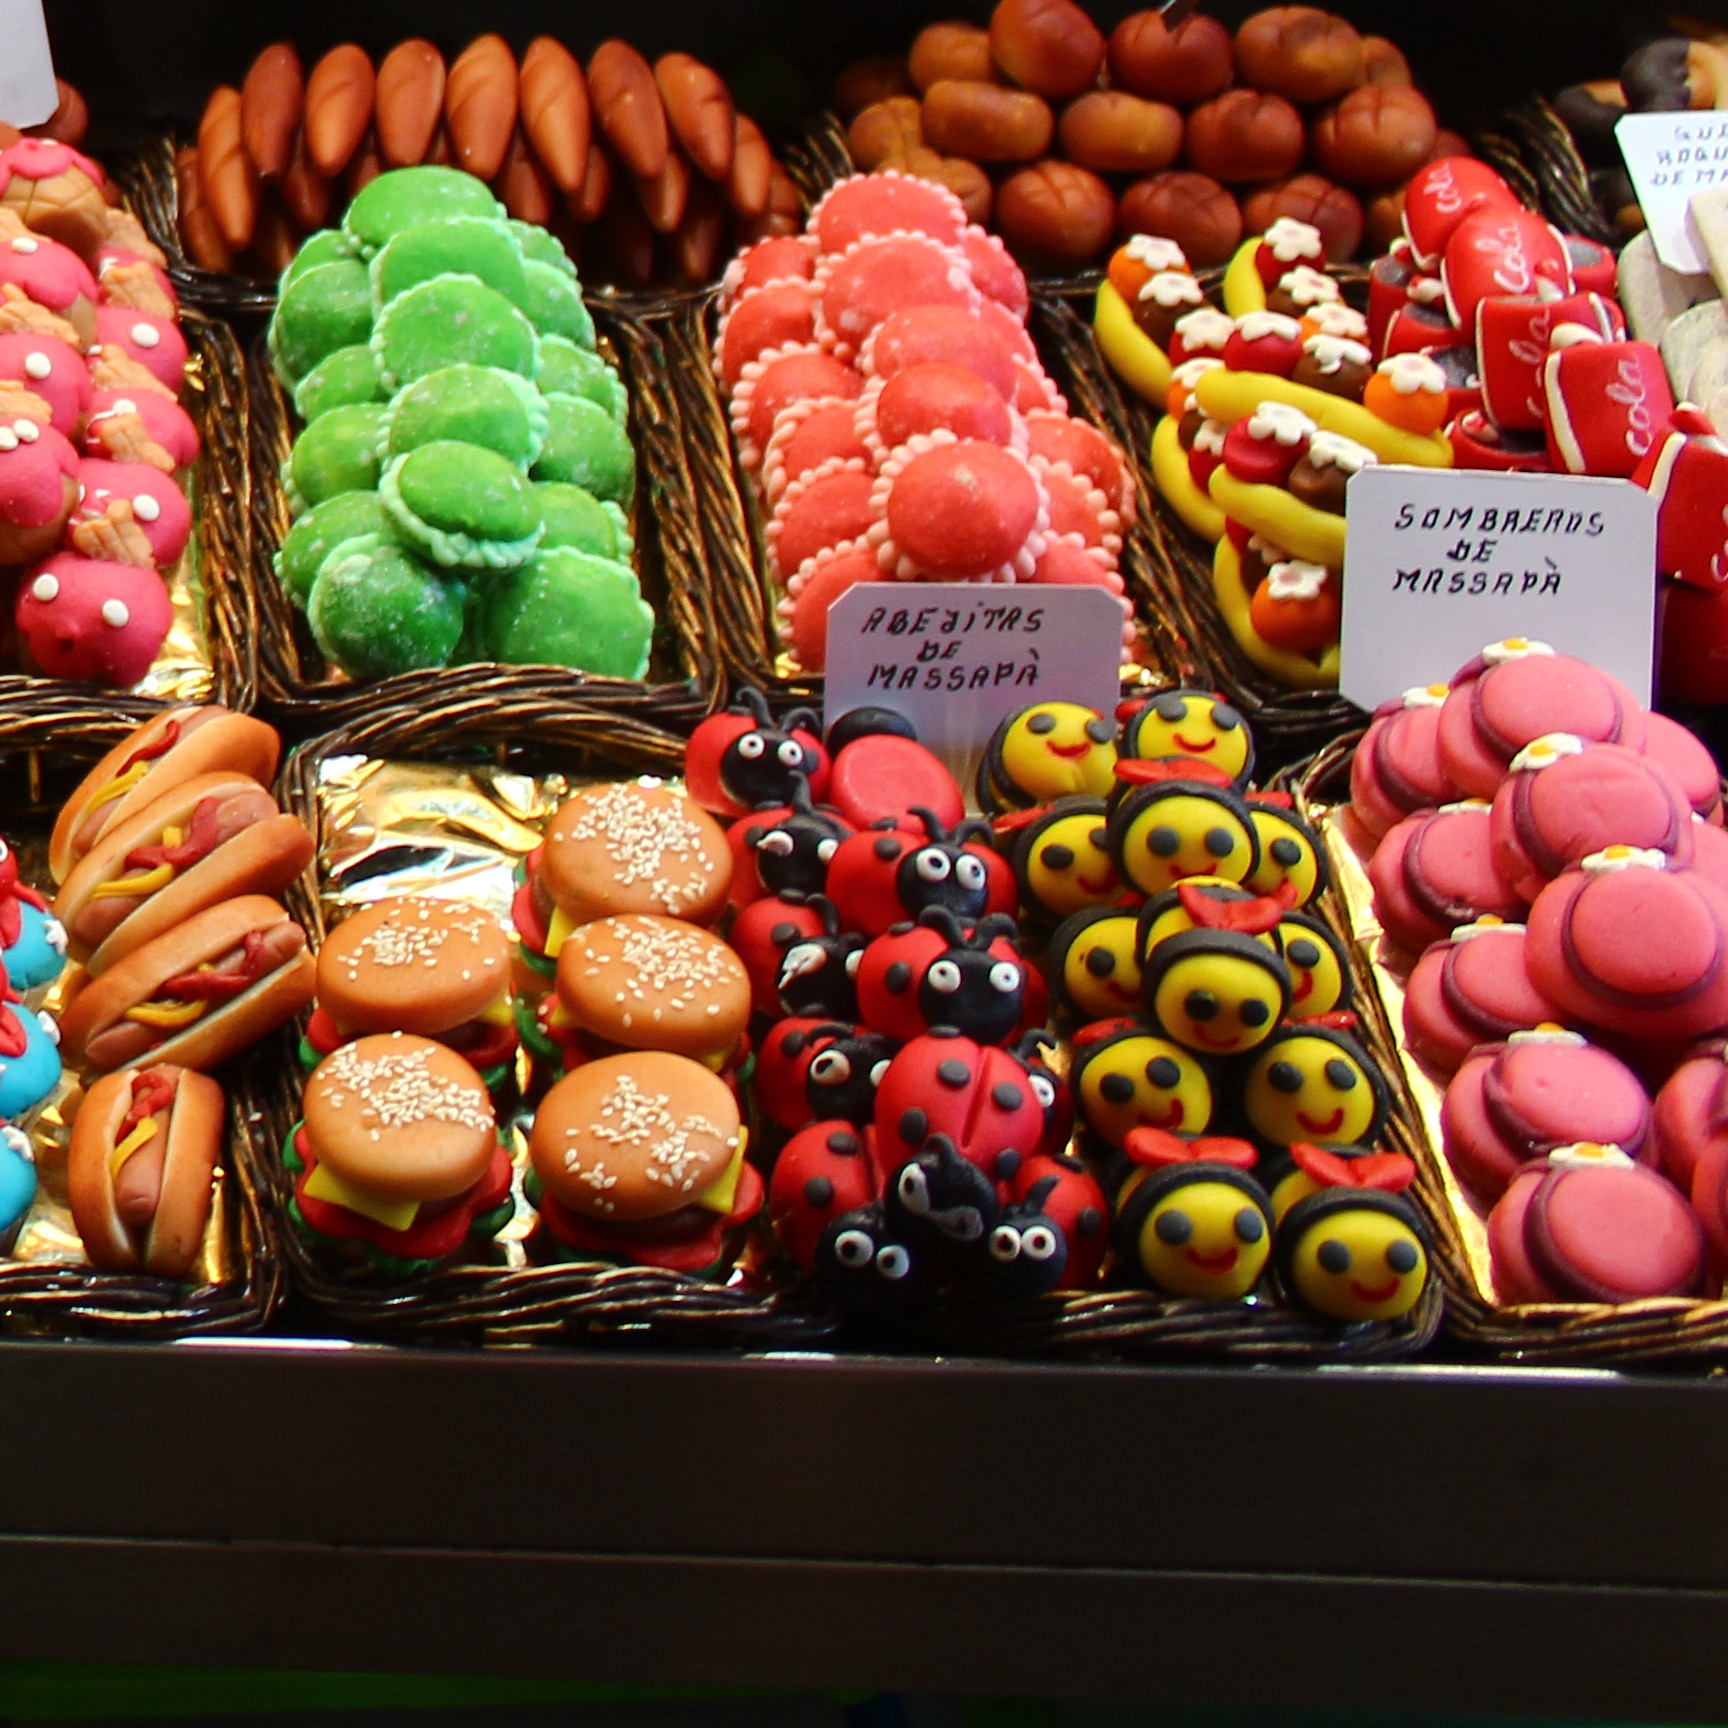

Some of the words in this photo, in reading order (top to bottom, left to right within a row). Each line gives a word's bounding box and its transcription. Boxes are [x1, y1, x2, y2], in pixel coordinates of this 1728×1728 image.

[1394, 502, 1605, 537] SOMBREROS
[1446, 538, 1498, 563] DE
[1392, 555, 1562, 596] MASSAPÀ
[861, 601, 1045, 637] ABEJITAS
[916, 639, 963, 663] DE
[866, 647, 1040, 692] MASSAPÀ
